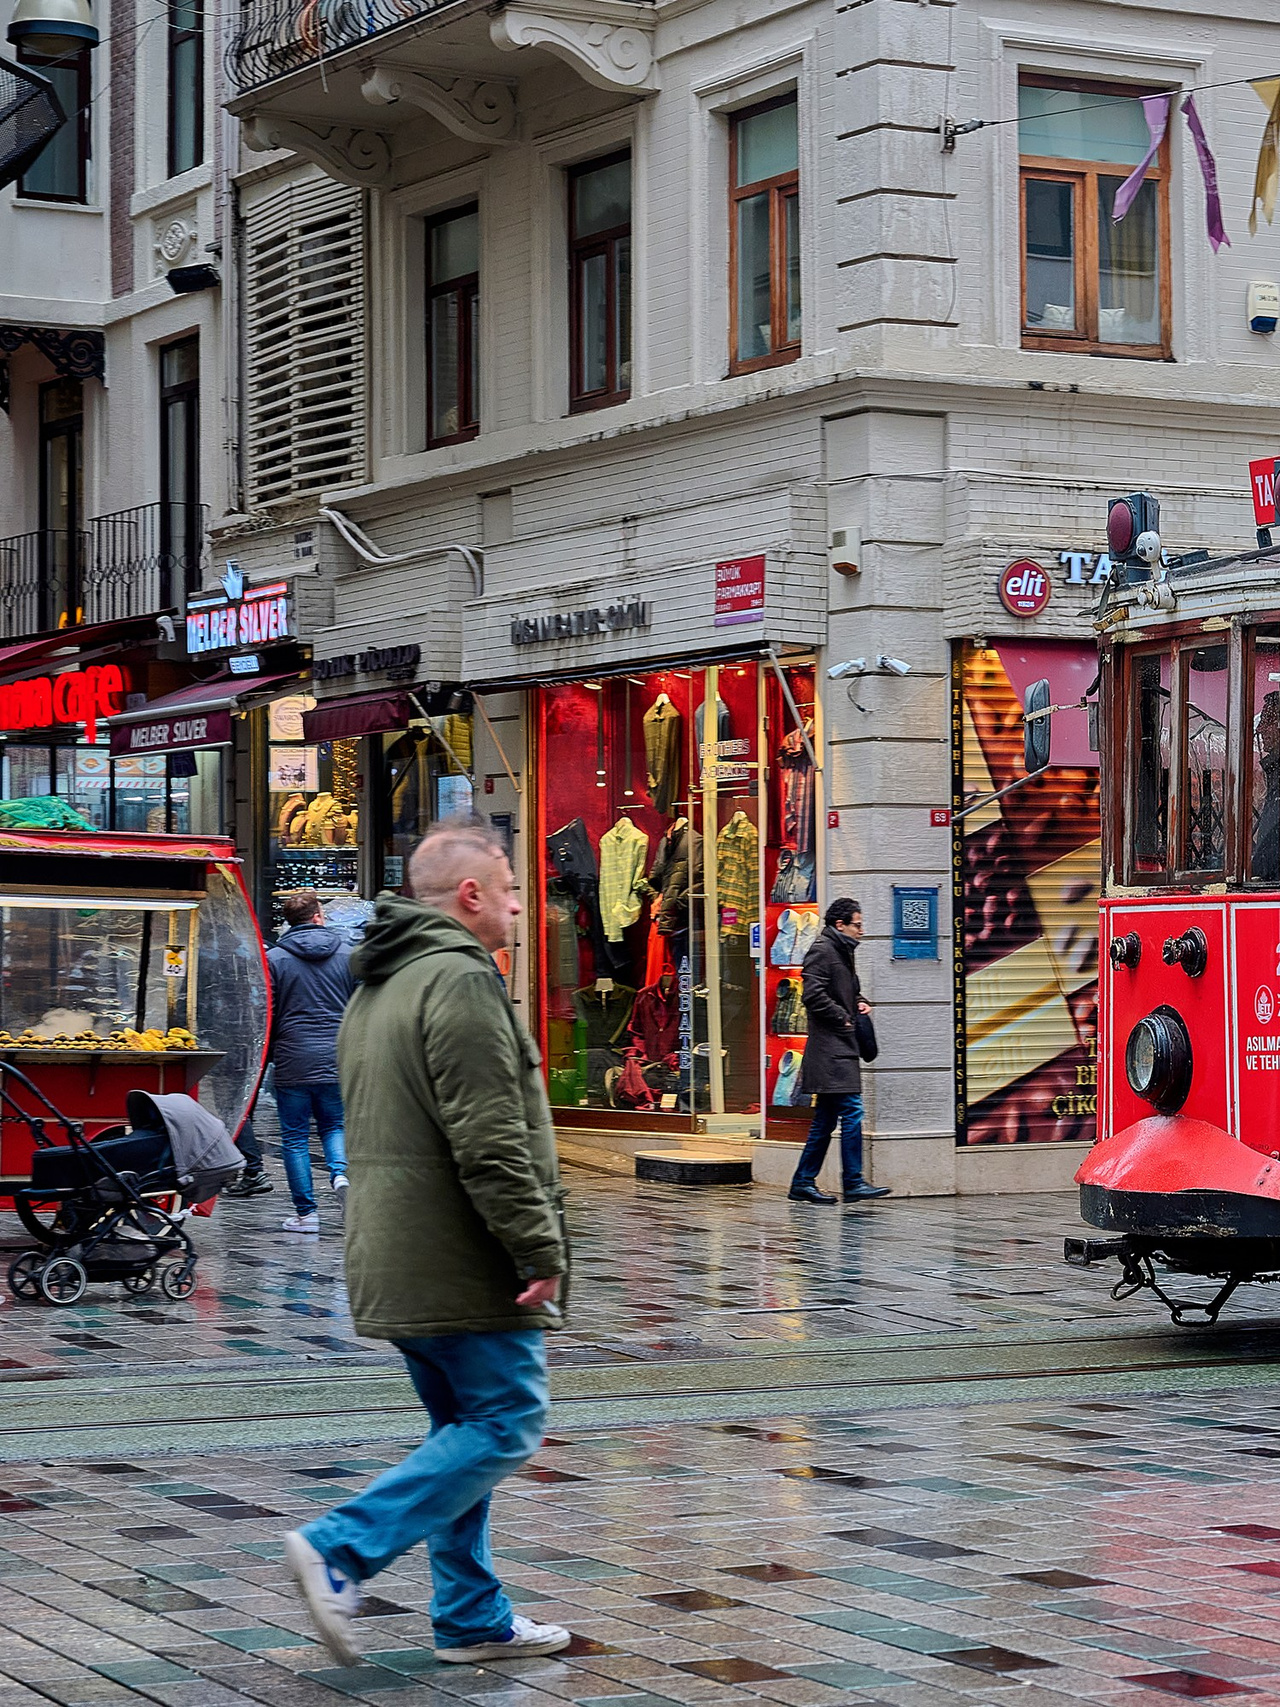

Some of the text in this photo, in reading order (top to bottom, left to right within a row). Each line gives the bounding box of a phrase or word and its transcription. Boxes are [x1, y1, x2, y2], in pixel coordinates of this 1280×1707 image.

[1006, 569, 1046, 596] elit
[186, 596, 288, 653] MELBER SILVER
[130, 718, 207, 748] MELBER SILVER
[829, 815, 836, 825] 2
[1245, 1055, 1258, 1071] VE
